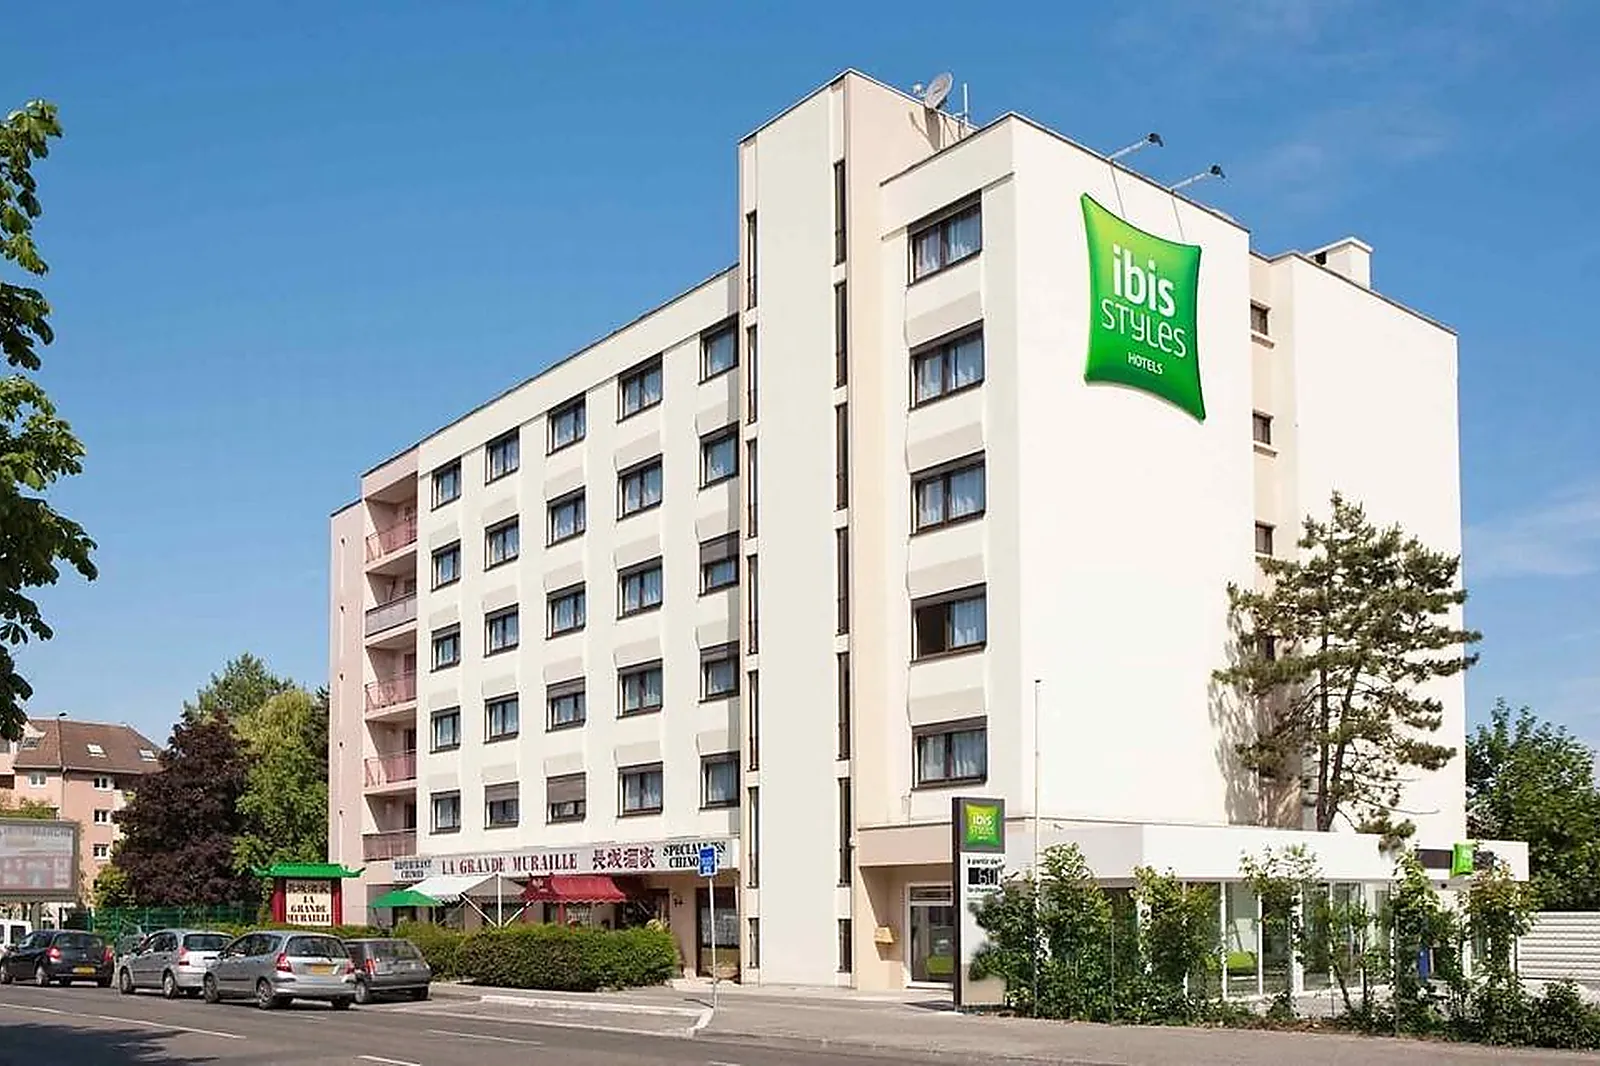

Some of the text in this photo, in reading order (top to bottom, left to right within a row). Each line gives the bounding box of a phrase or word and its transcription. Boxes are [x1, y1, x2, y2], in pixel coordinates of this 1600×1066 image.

[1113, 243, 1175, 317] ibis
[1127, 351, 1163, 375] HOTELS
[442, 853, 578, 875] LA GRANDE MURAILLE
[303, 895, 314, 904] LA
[290, 904, 327, 913] GRANDE
[287, 913, 330, 923] MURAILLE
